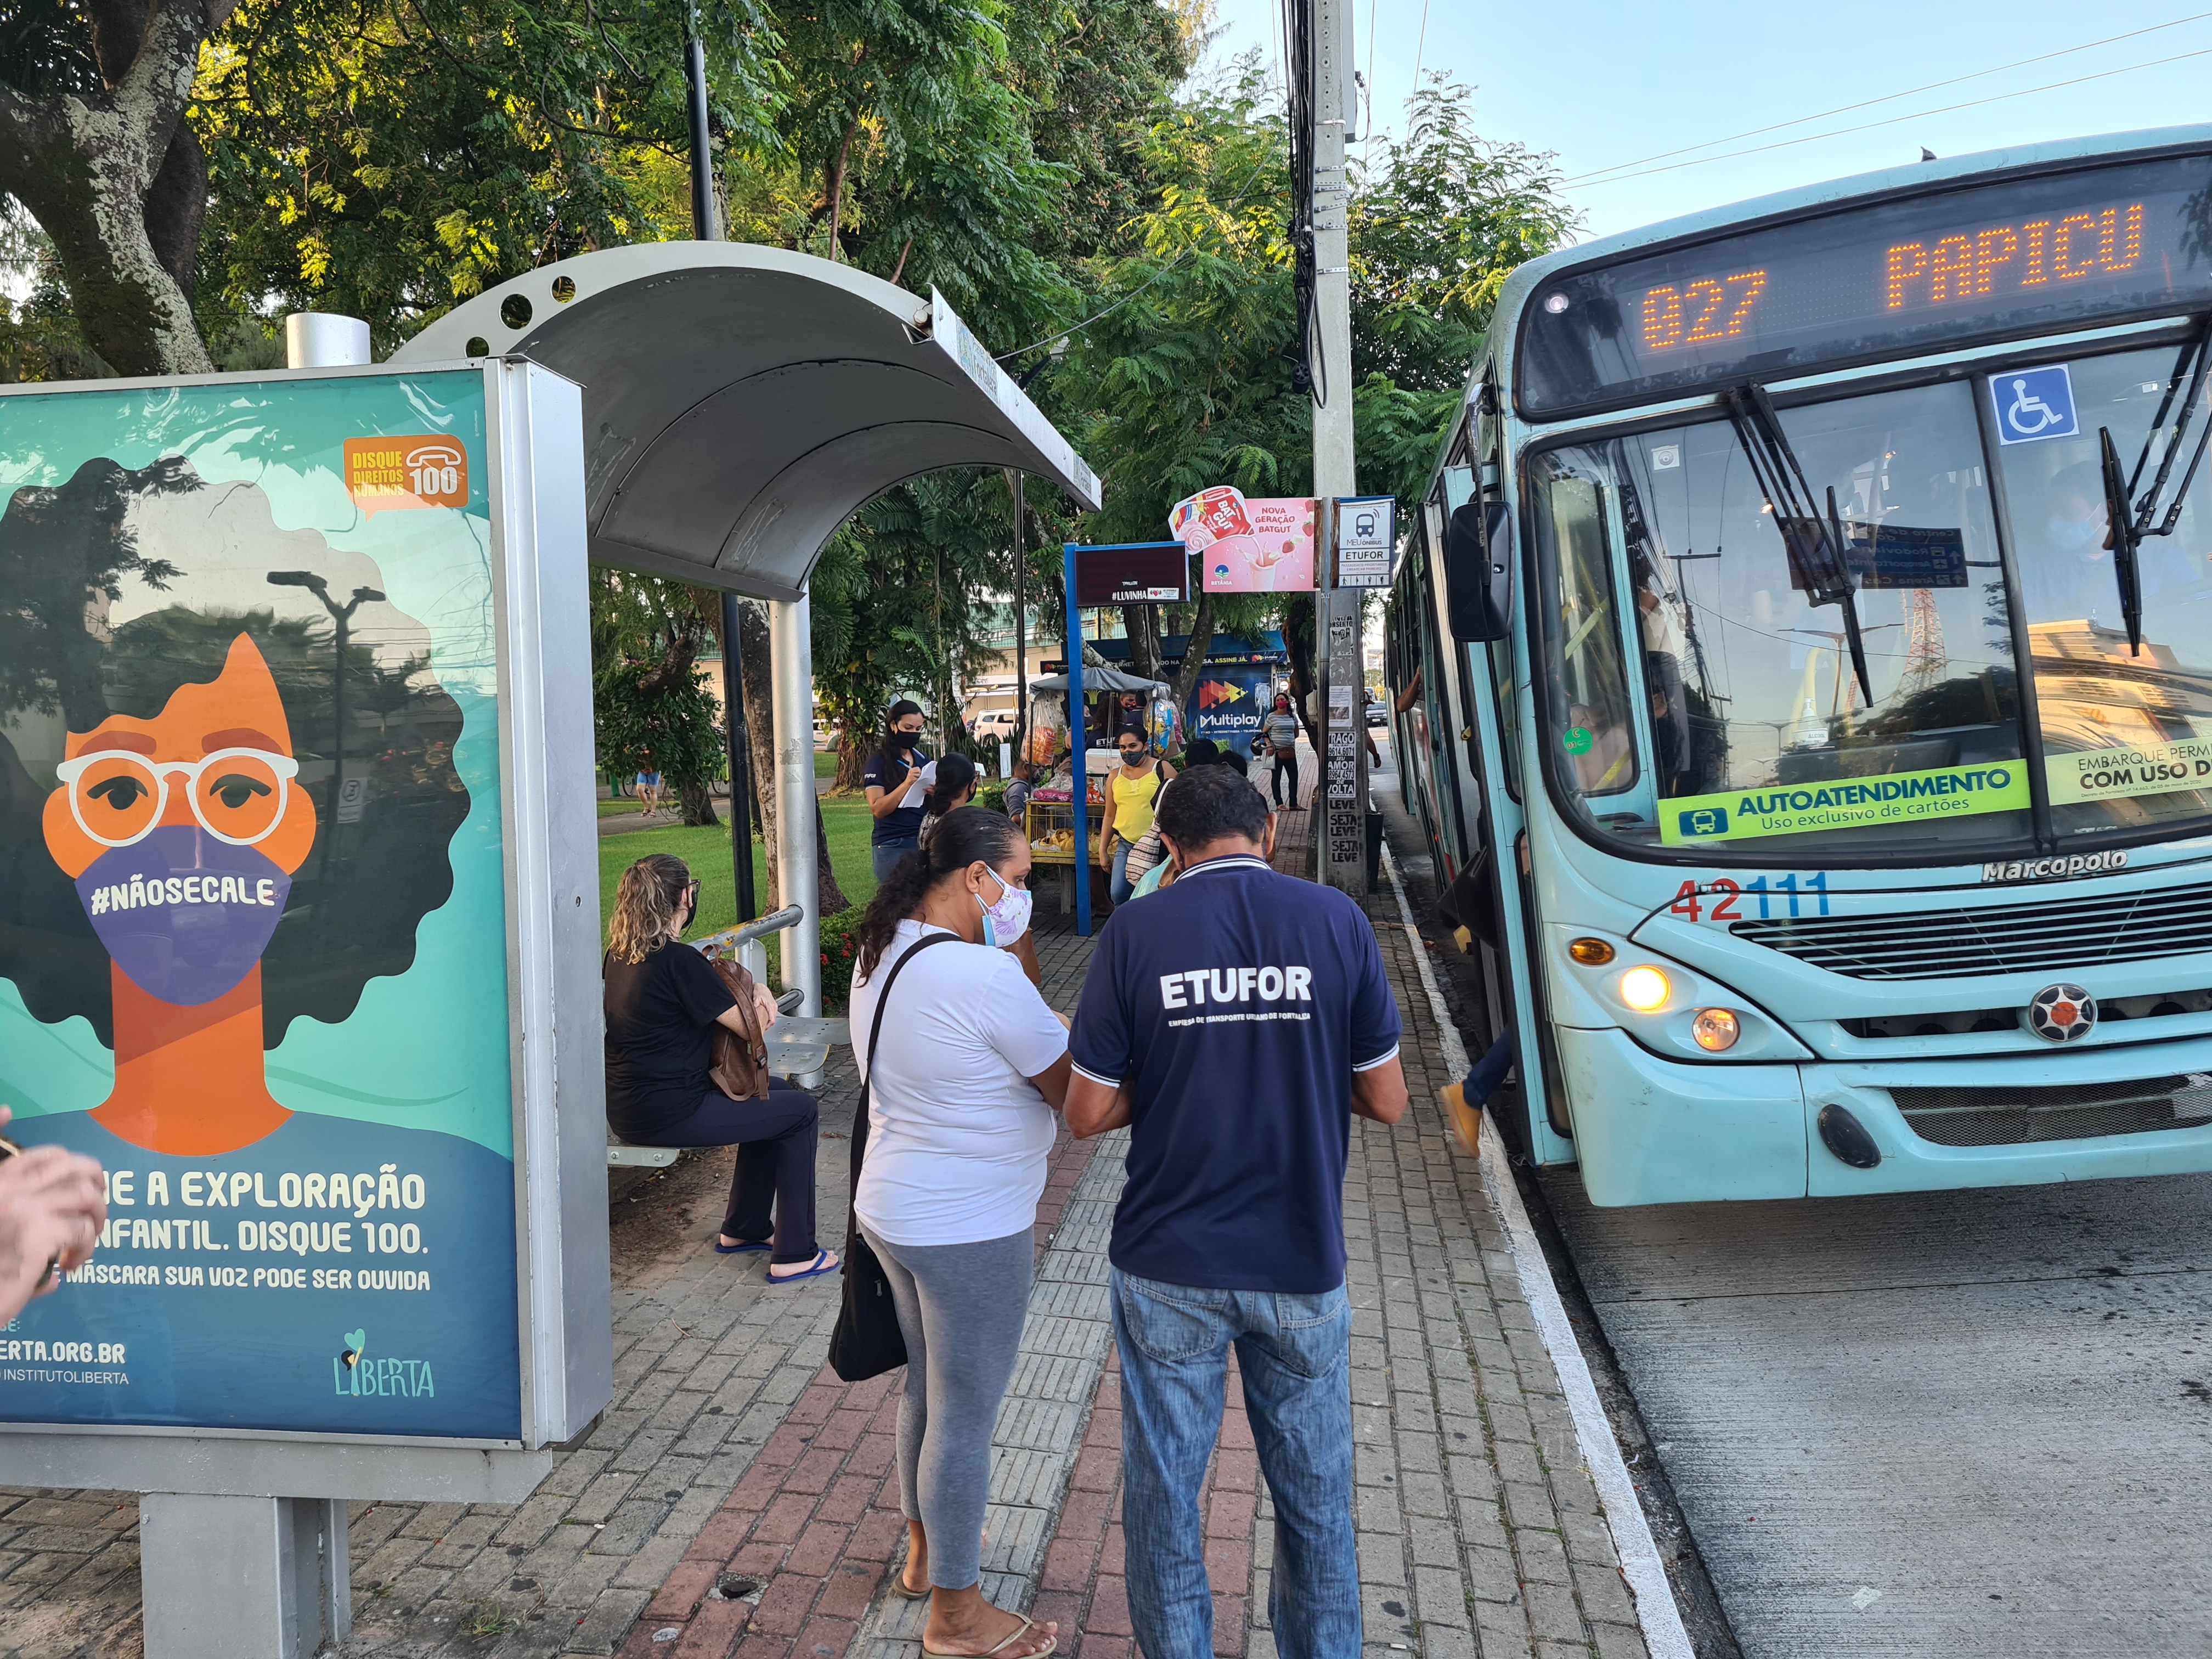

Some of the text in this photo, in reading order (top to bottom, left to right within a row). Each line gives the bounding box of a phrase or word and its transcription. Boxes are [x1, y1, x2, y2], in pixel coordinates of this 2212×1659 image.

[1642, 203, 2145, 348] 027 PAPICU
[353, 451, 403, 469] DISQUE
[353, 469, 404, 484] DIREITOS
[409, 466, 458, 495] 100
[353, 484, 404, 498] HUMANOS
[1217, 500, 1236, 518] BAT
[1213, 511, 1234, 530] GUT
[1255, 515, 1296, 524] GERAÇÃO
[1259, 525, 1291, 533] BATGUT
[1346, 551, 1384, 560] ETUFOR
[1112, 590, 1147, 601] #LUVINHA
[1200, 713, 1261, 728] Multiplay
[1572, 729, 1581, 738] C
[1328, 761, 1355, 770] AMOR
[2078, 749, 2164, 771] EMBARQUE
[2080, 759, 2212, 789] COM USO D
[1737, 769, 2011, 817] AUTOATENDIMENTO
[1330, 800, 1356, 810] LEVE
[1761, 798, 1969, 830] Uso exclusivo de cartões
[1330, 814, 1357, 826] SEJA
[1330, 826, 1356, 837] LEVE
[1332, 840, 1358, 852] SEJA
[1332, 853, 1358, 862] LEVE
[1982, 849, 2128, 882] Marcopolo
[91, 873, 275, 916] #NÃOSECALE
[1670, 871, 1829, 922] 42111
[1160, 966, 1312, 1009] ETUFOR
[1206, 1014, 1245, 1023] TRANSPORTE
[147, 1171, 170, 1206] A
[180, 1163, 425, 1218] EXPLORAÇÃO
[94, 1218, 428, 1256] NFANTIL. DISQUE 100.
[66, 1259, 160, 1285] MÁSCARA
[165, 1266, 204, 1286] SUA
[208, 1267, 249, 1287] VOZ
[253, 1268, 307, 1288] PODE
[312, 1268, 352, 1289] SER
[357, 1269, 431, 1291] OUVIDA
[4, 1369, 129, 1385] INSTITUTOLIBERTA
[333, 1356, 435, 1398] LIBERTA
